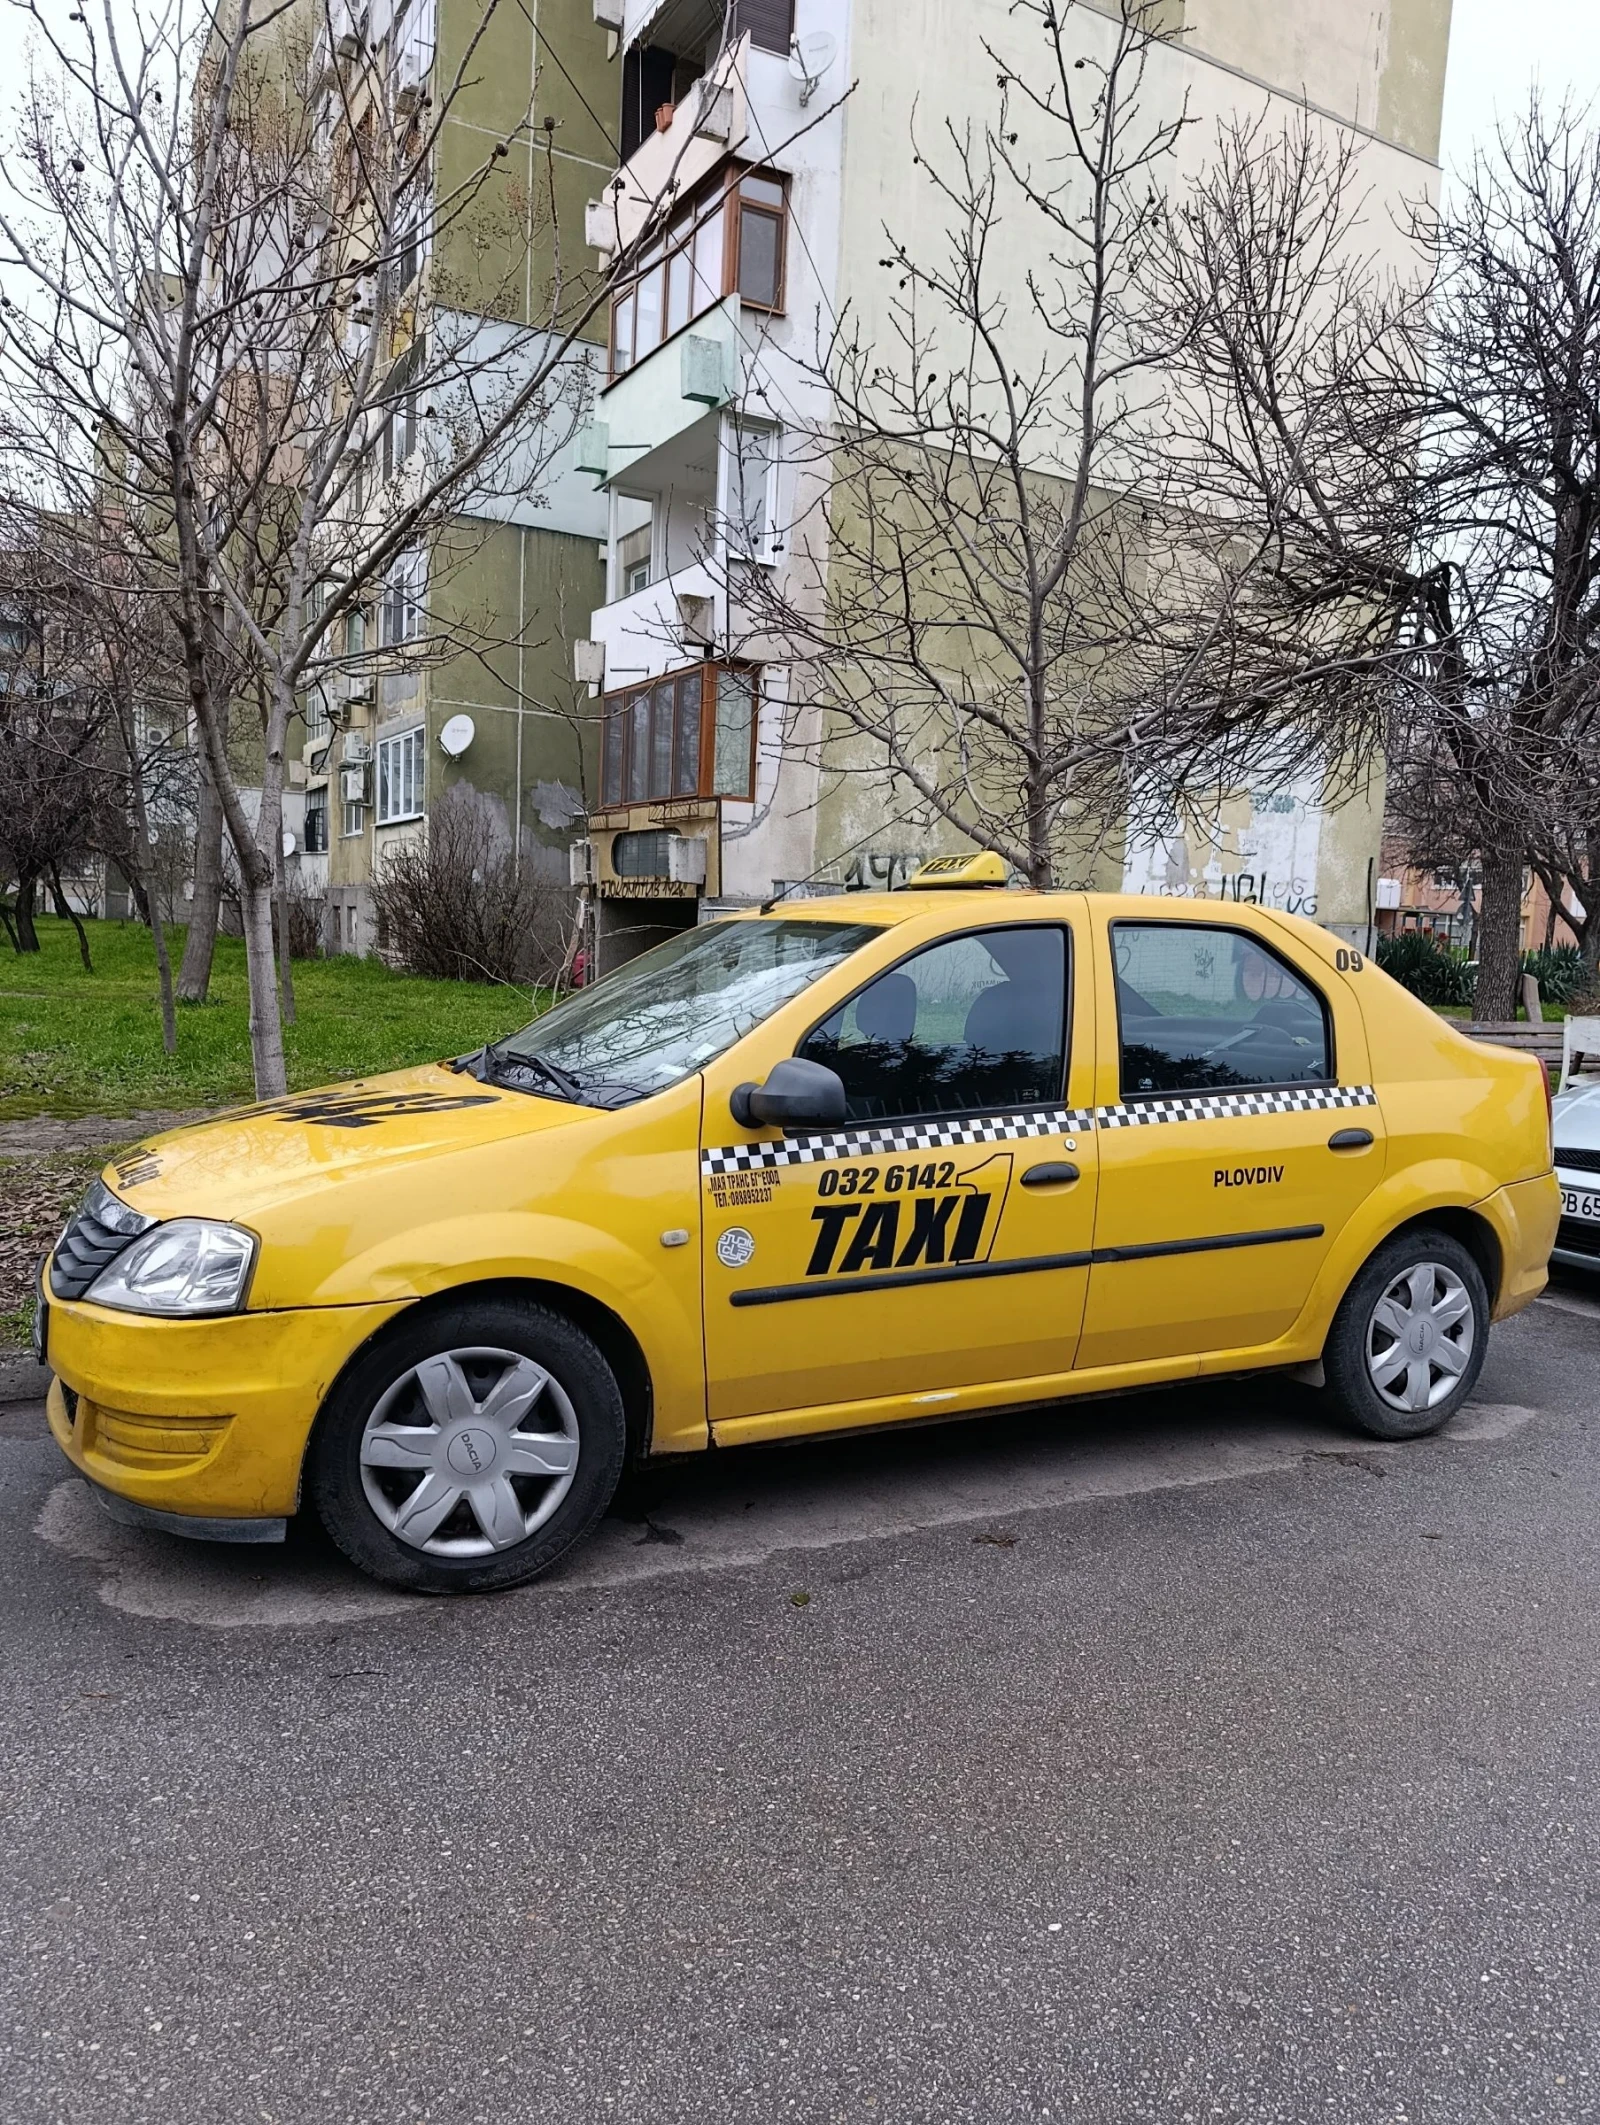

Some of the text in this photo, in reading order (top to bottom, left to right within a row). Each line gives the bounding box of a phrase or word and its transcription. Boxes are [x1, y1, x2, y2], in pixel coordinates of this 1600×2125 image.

[928, 856, 976, 871] TAXI
[1335, 948, 1364, 973] 09
[726, 1173, 750, 1190] ТРАНС
[817, 1160, 956, 1197] 032 6142
[1214, 1165, 1285, 1188] PLOVDIV
[1581, 1196, 1600, 1217] 65
[805, 1193, 992, 1276] TAXI
[1418, 1323, 1426, 1352] DACIA
[461, 1433, 483, 1472] DACIA
